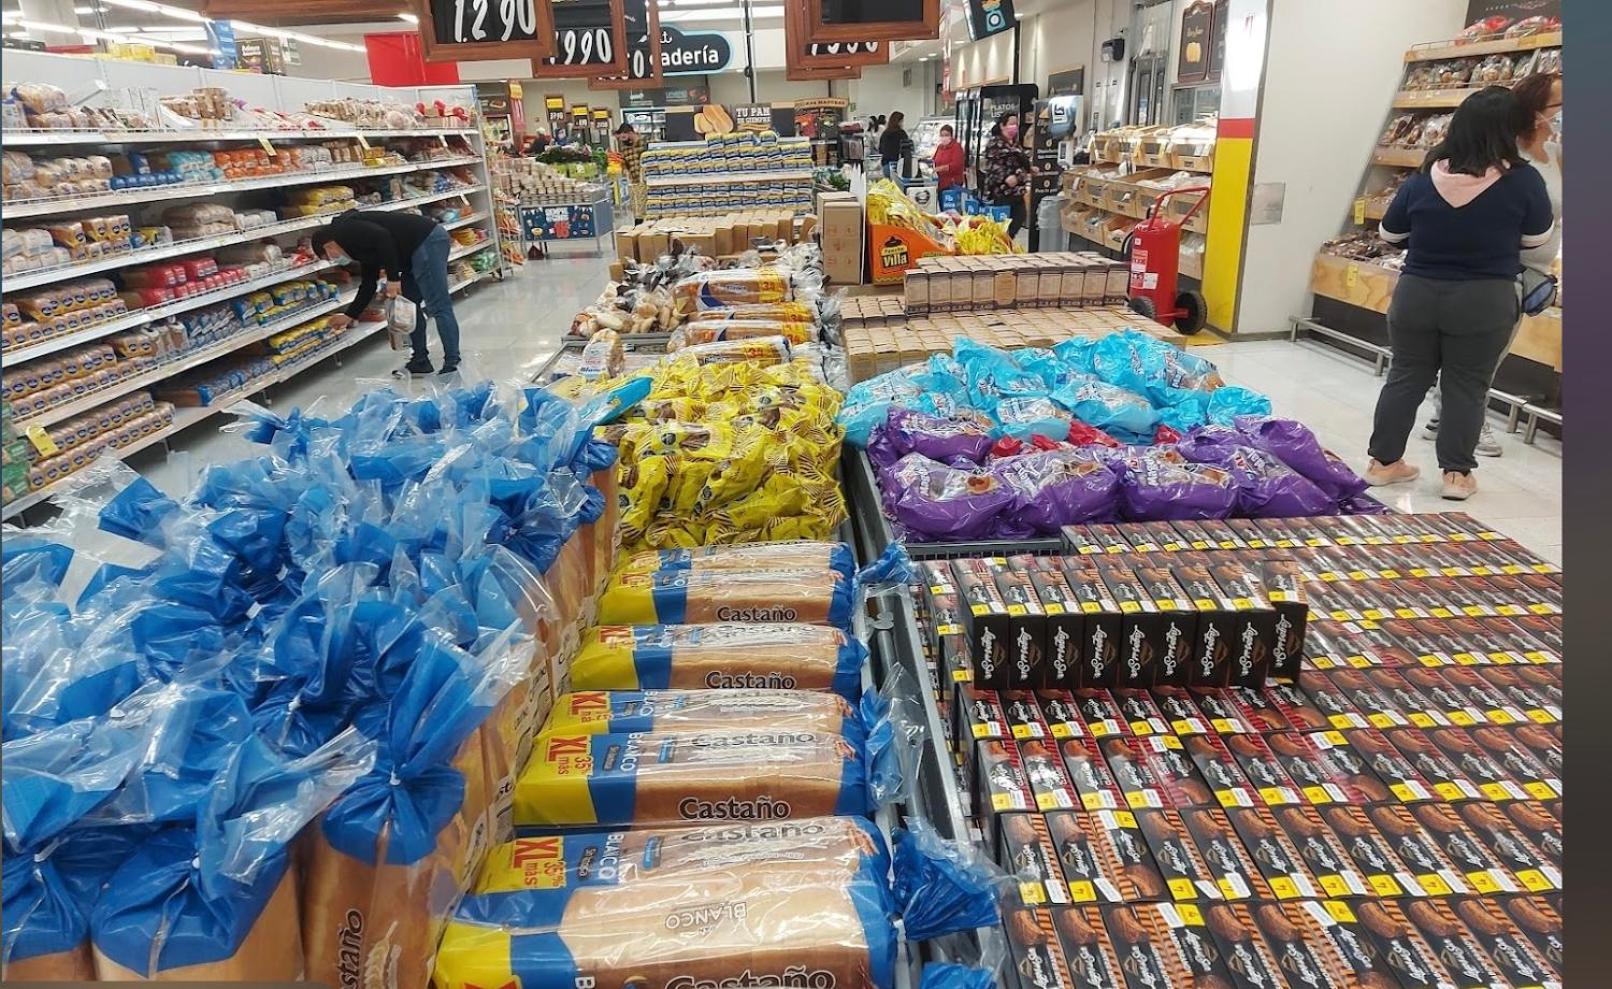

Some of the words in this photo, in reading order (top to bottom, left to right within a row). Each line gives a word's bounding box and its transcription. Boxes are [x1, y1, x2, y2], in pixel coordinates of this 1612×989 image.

[883, 253, 907, 267] Villa
[717, 604, 797, 623] Castaño
[705, 671, 796, 691] Castaño
[548, 736, 588, 762] XL
[678, 796, 791, 821] Castaño
[514, 838, 559, 869] XL
[598, 833, 624, 880] BLANCO
[665, 901, 748, 930] BLANCO
